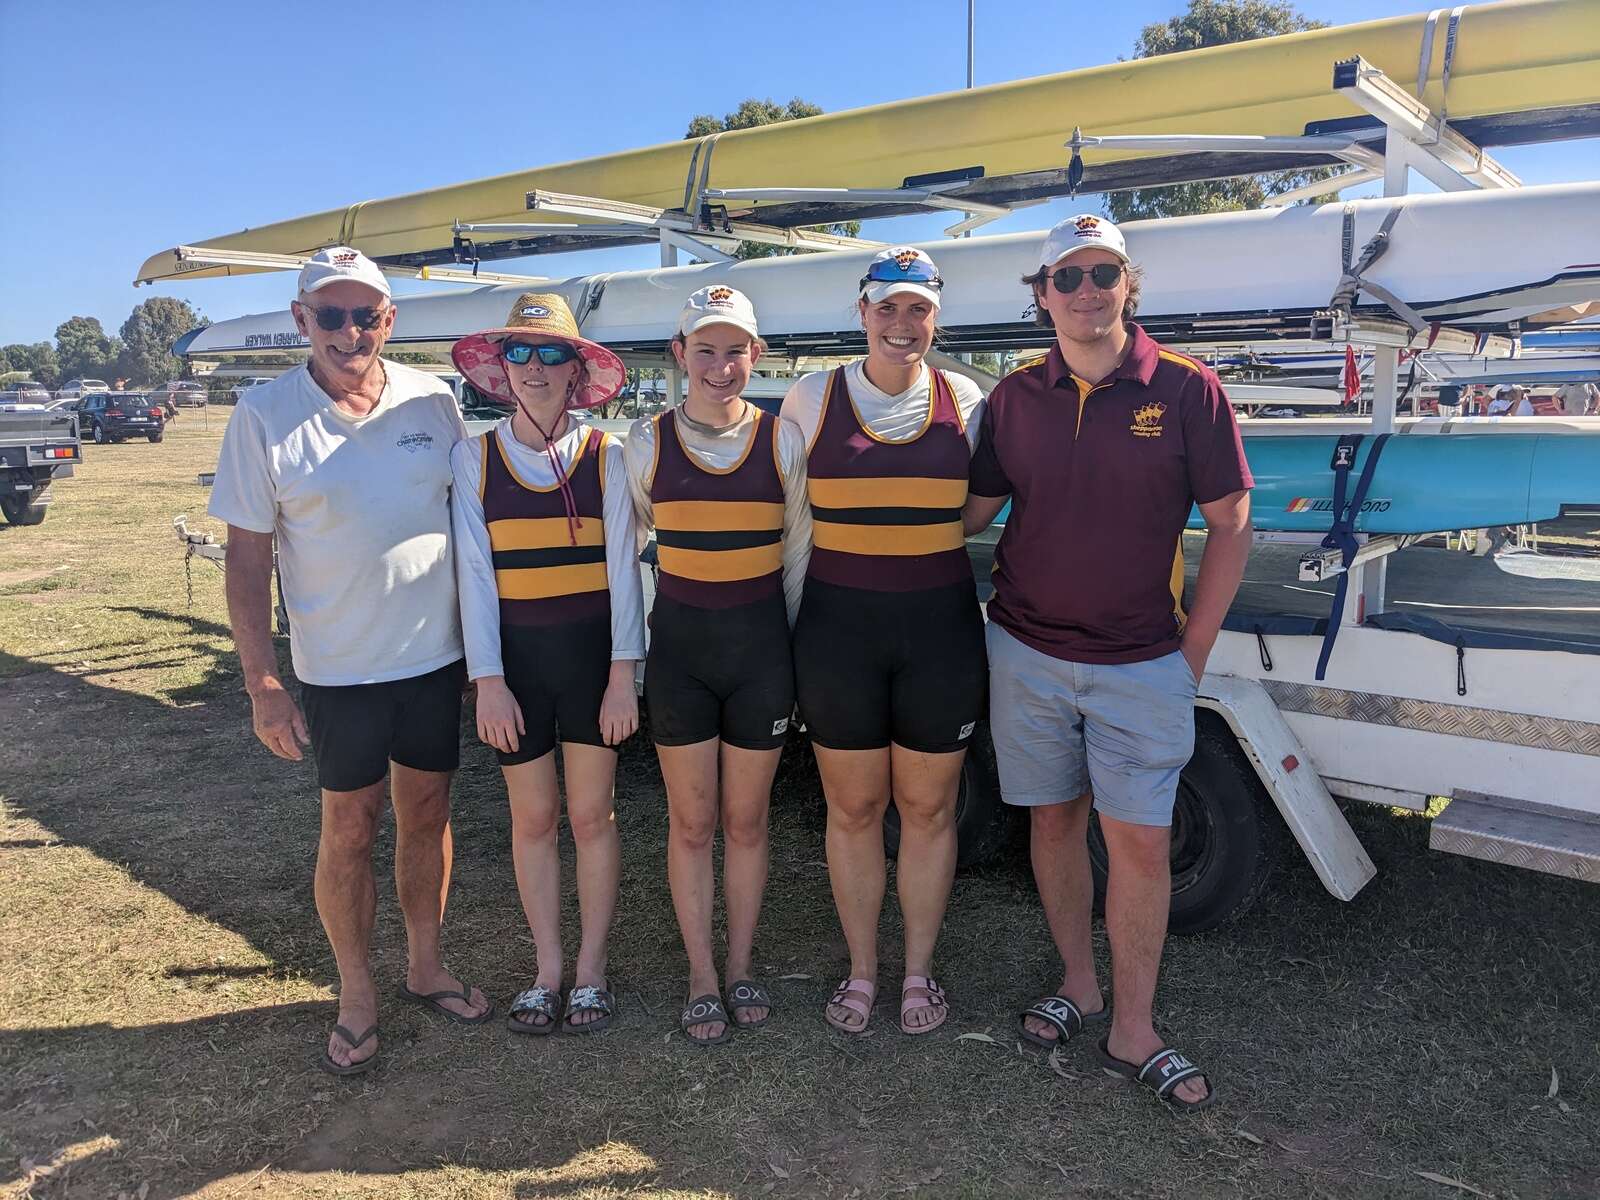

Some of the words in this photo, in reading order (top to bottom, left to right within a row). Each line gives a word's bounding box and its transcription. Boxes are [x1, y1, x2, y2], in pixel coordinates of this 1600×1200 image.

[522, 307, 548, 315] BCF
[244, 333, 272, 348] WALKER
[273, 332, 302, 346] DARREN
[1032, 1000, 1068, 1021] FILA
[1157, 1054, 1193, 1077] FILA
